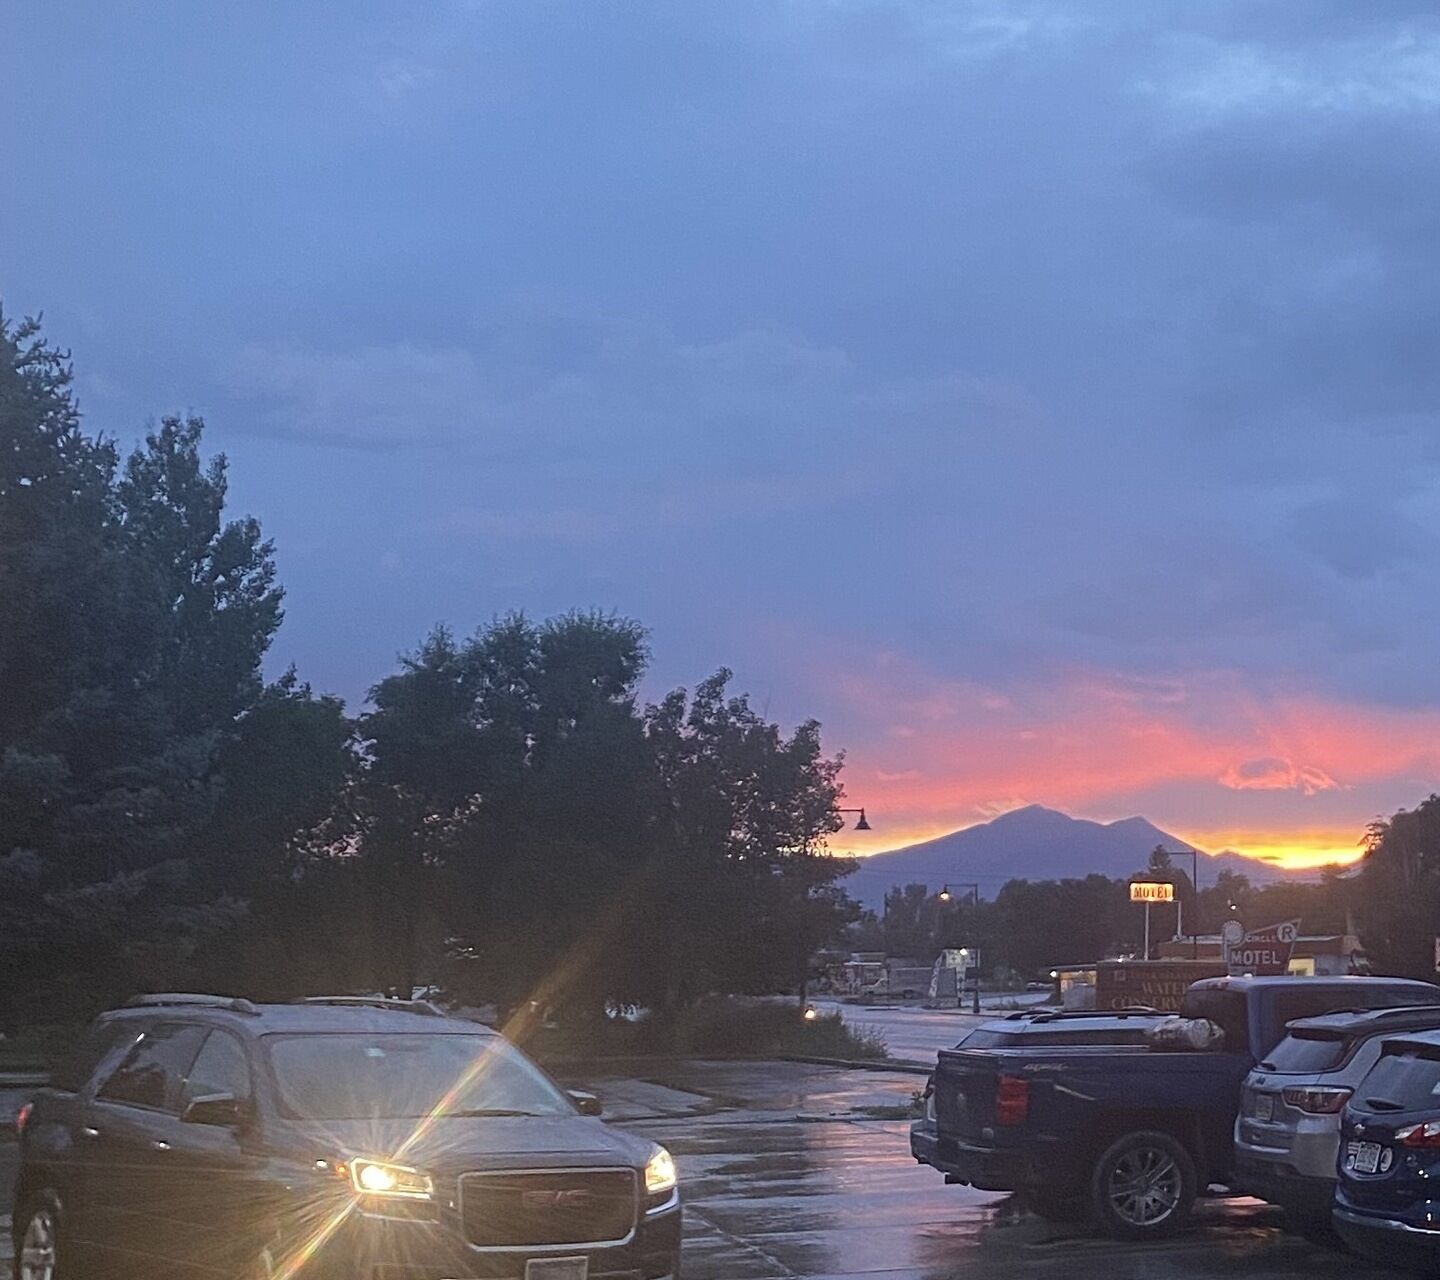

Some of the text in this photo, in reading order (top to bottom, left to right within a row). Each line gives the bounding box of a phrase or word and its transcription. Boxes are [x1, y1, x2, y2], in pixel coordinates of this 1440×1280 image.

[1133, 886, 1170, 898] MOTEL
[1246, 935, 1278, 943] CIRCLE
[1231, 950, 1281, 965] MOTEL
